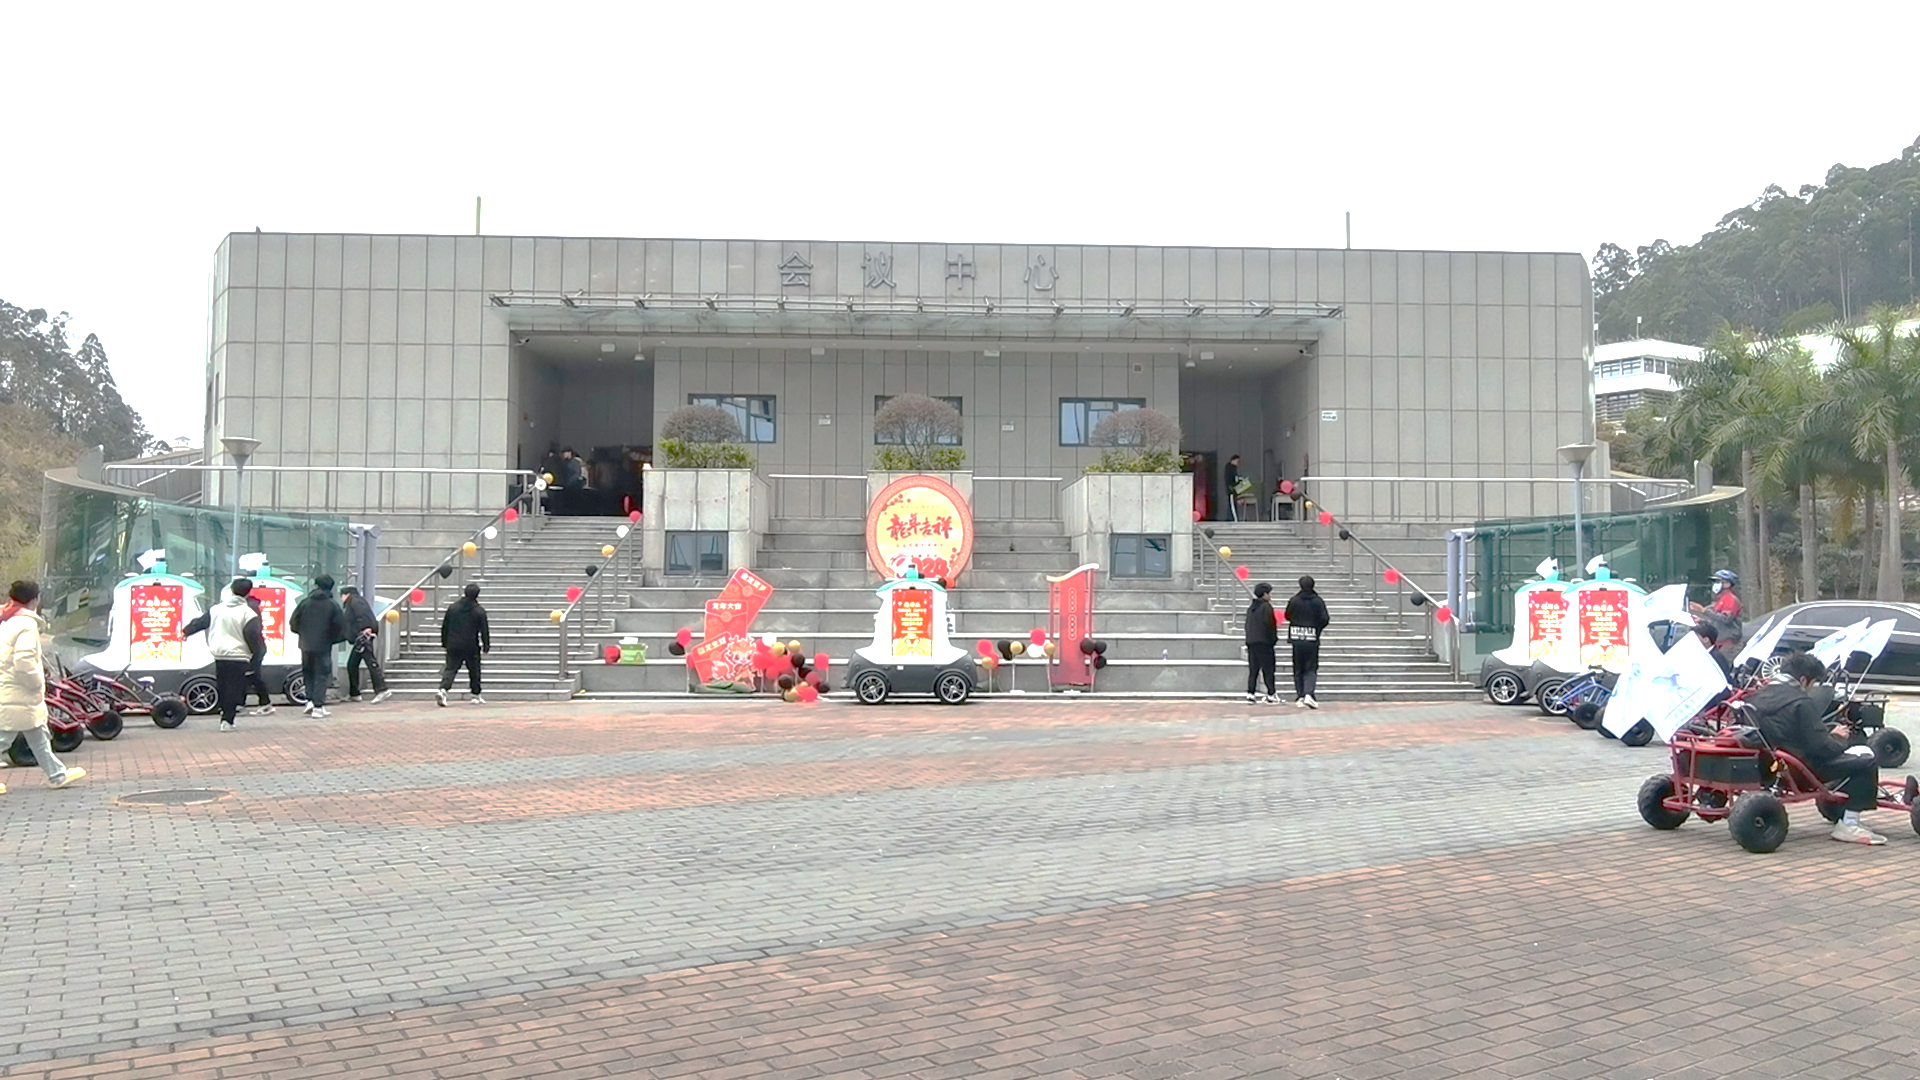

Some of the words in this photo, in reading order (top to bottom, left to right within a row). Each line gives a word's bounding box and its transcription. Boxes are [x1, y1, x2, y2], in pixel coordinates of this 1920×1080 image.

[778, 251, 1059, 291] 会议中心
[896, 556, 949, 578] 24
